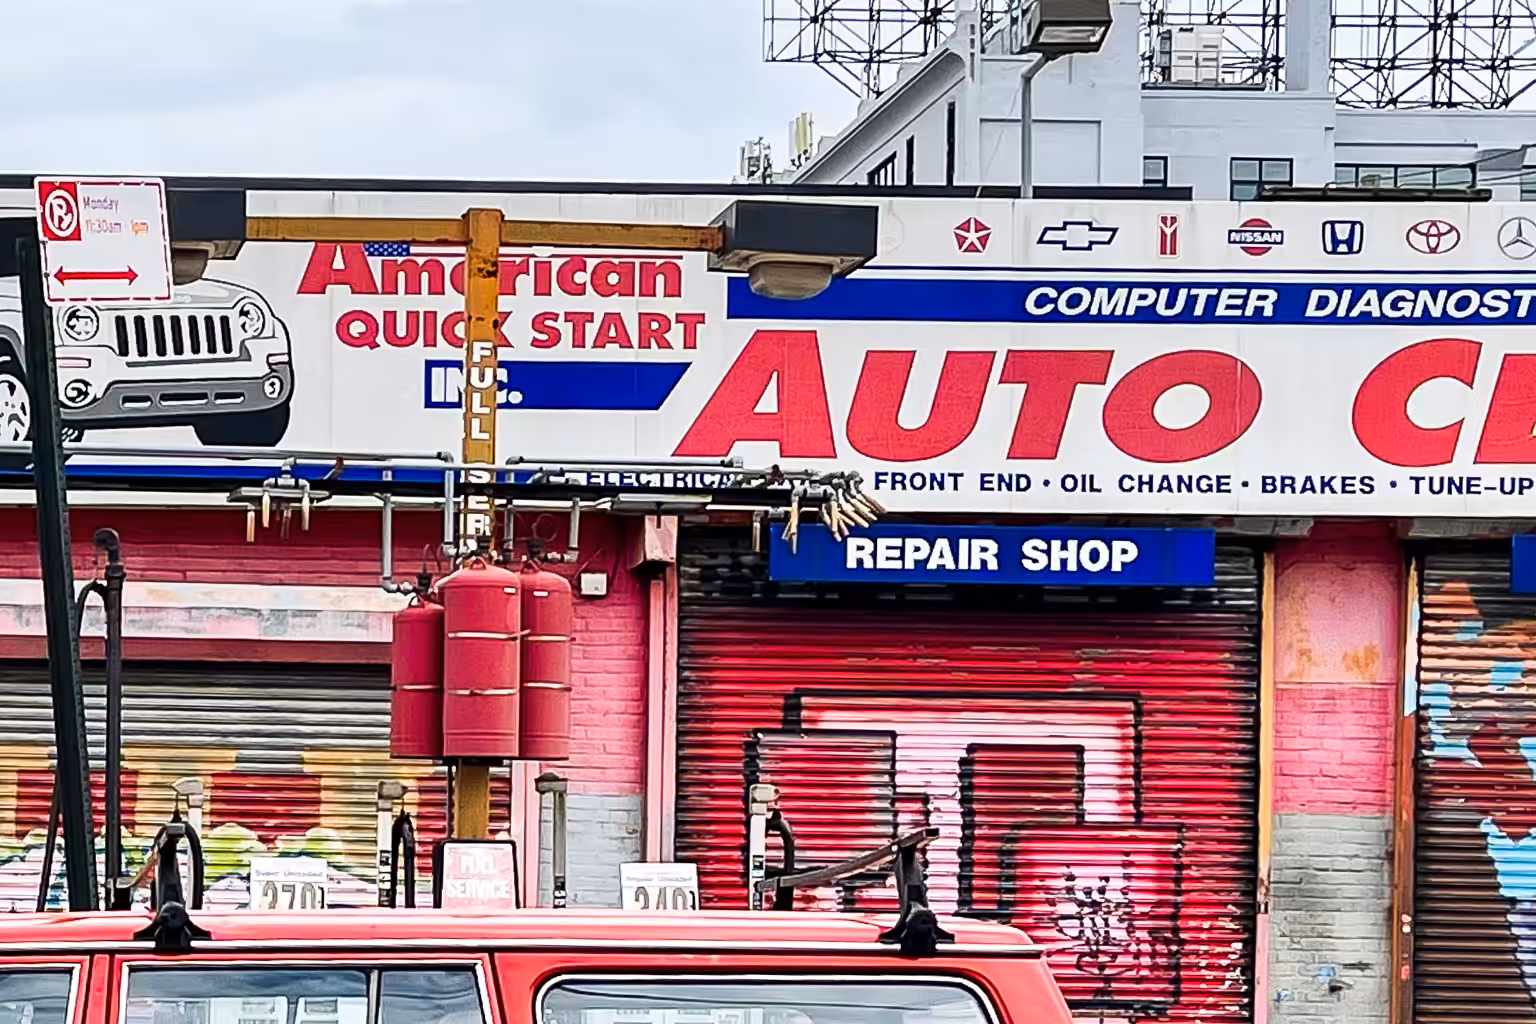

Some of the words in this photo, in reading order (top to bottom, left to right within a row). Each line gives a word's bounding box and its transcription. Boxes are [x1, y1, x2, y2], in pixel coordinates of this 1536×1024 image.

[1229, 231, 1282, 243] NISSAN
[1024, 286, 1279, 318] COMPUTER
[1305, 288, 1536, 319] DIAGNOST
[530, 311, 706, 350] START
[672, 329, 1263, 463] AUTO
[874, 471, 965, 493] FRONT
[979, 472, 1033, 493] END
[1060, 473, 1103, 494] OIL
[1117, 473, 1232, 494] CHANGE
[1261, 474, 1376, 495] BRAKES
[1409, 475, 1535, 496] TUNE-UP
[846, 538, 999, 572] REPAIR
[1020, 538, 1140, 573] SHOP
[459, 854, 498, 875] FULL
[445, 879, 512, 899] SERVICE
